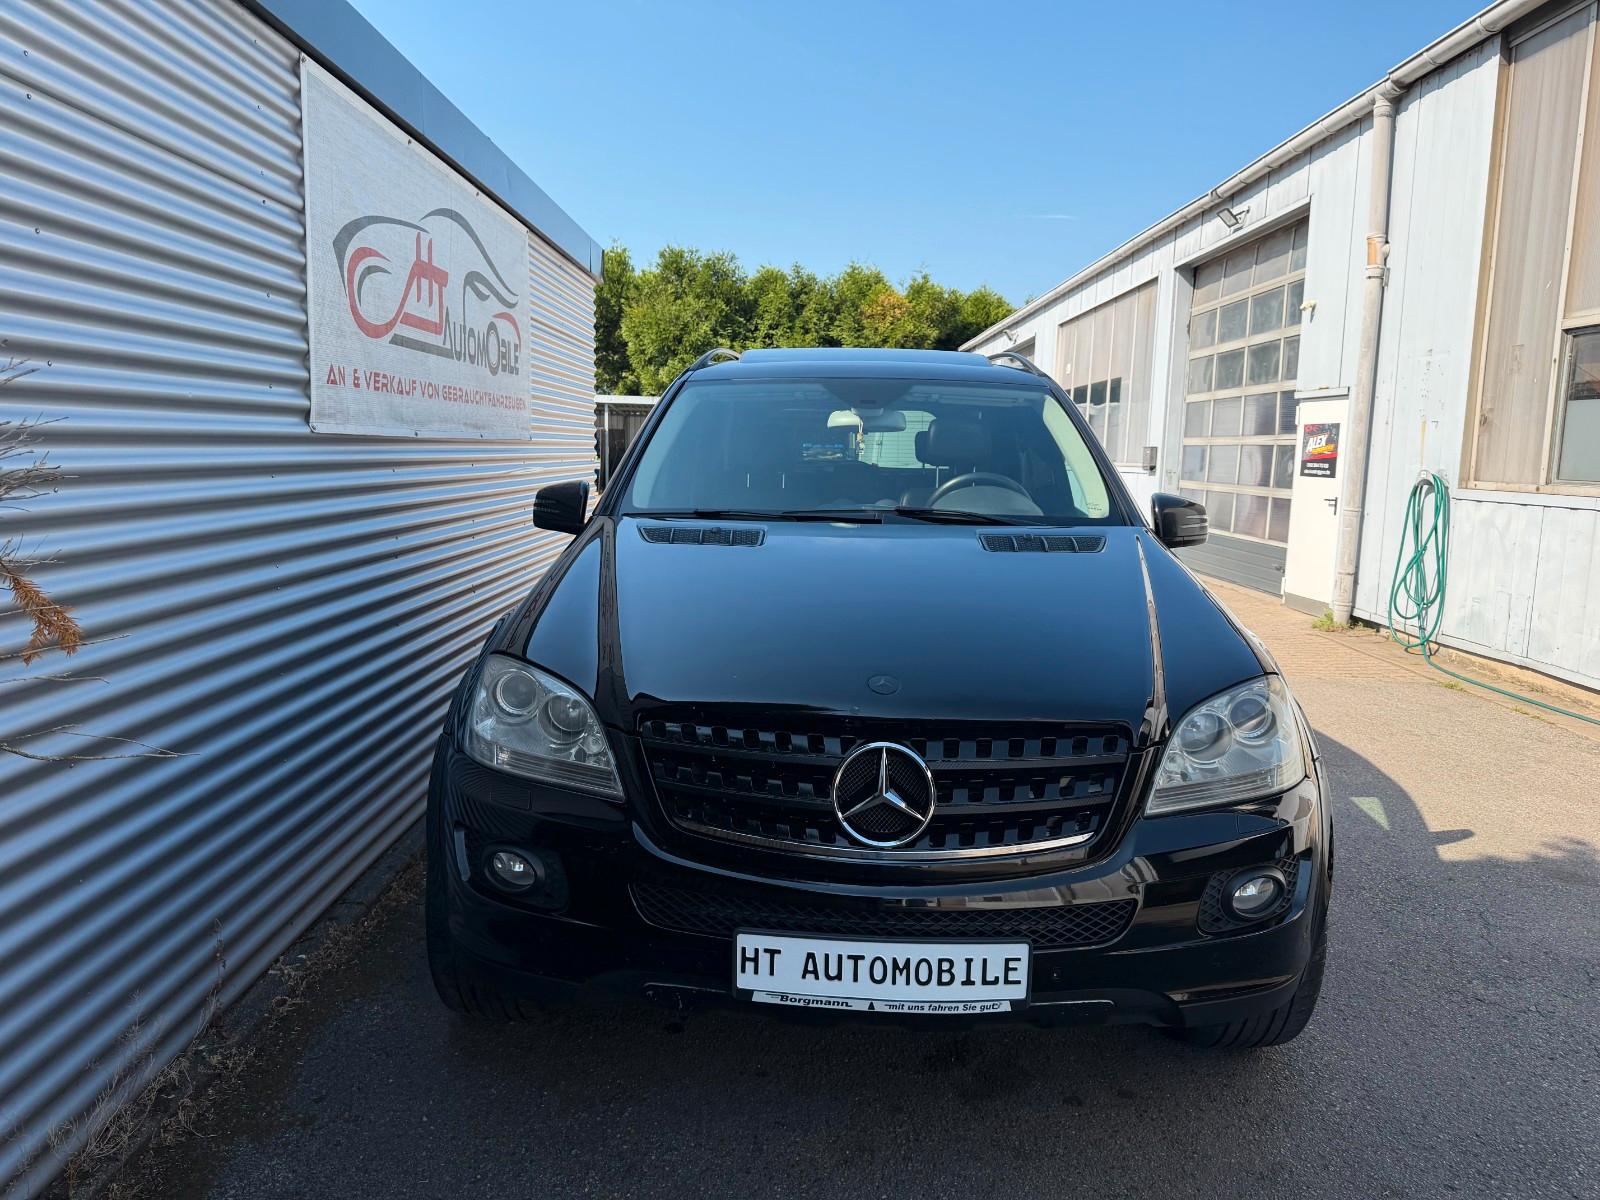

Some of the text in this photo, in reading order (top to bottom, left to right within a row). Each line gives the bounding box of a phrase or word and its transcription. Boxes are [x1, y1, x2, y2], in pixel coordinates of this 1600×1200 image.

[326, 363, 527, 410] AN & VERKAUF VON GEBRAUCHTFAHRZEUGEN
[740, 946, 1022, 987] HT AUTOMOBILE
[779, 994, 850, 1007] Borgmann
[888, 1003, 905, 1011] mit
[927, 1003, 959, 1012] fahren
[962, 1003, 977, 1011] Sie
